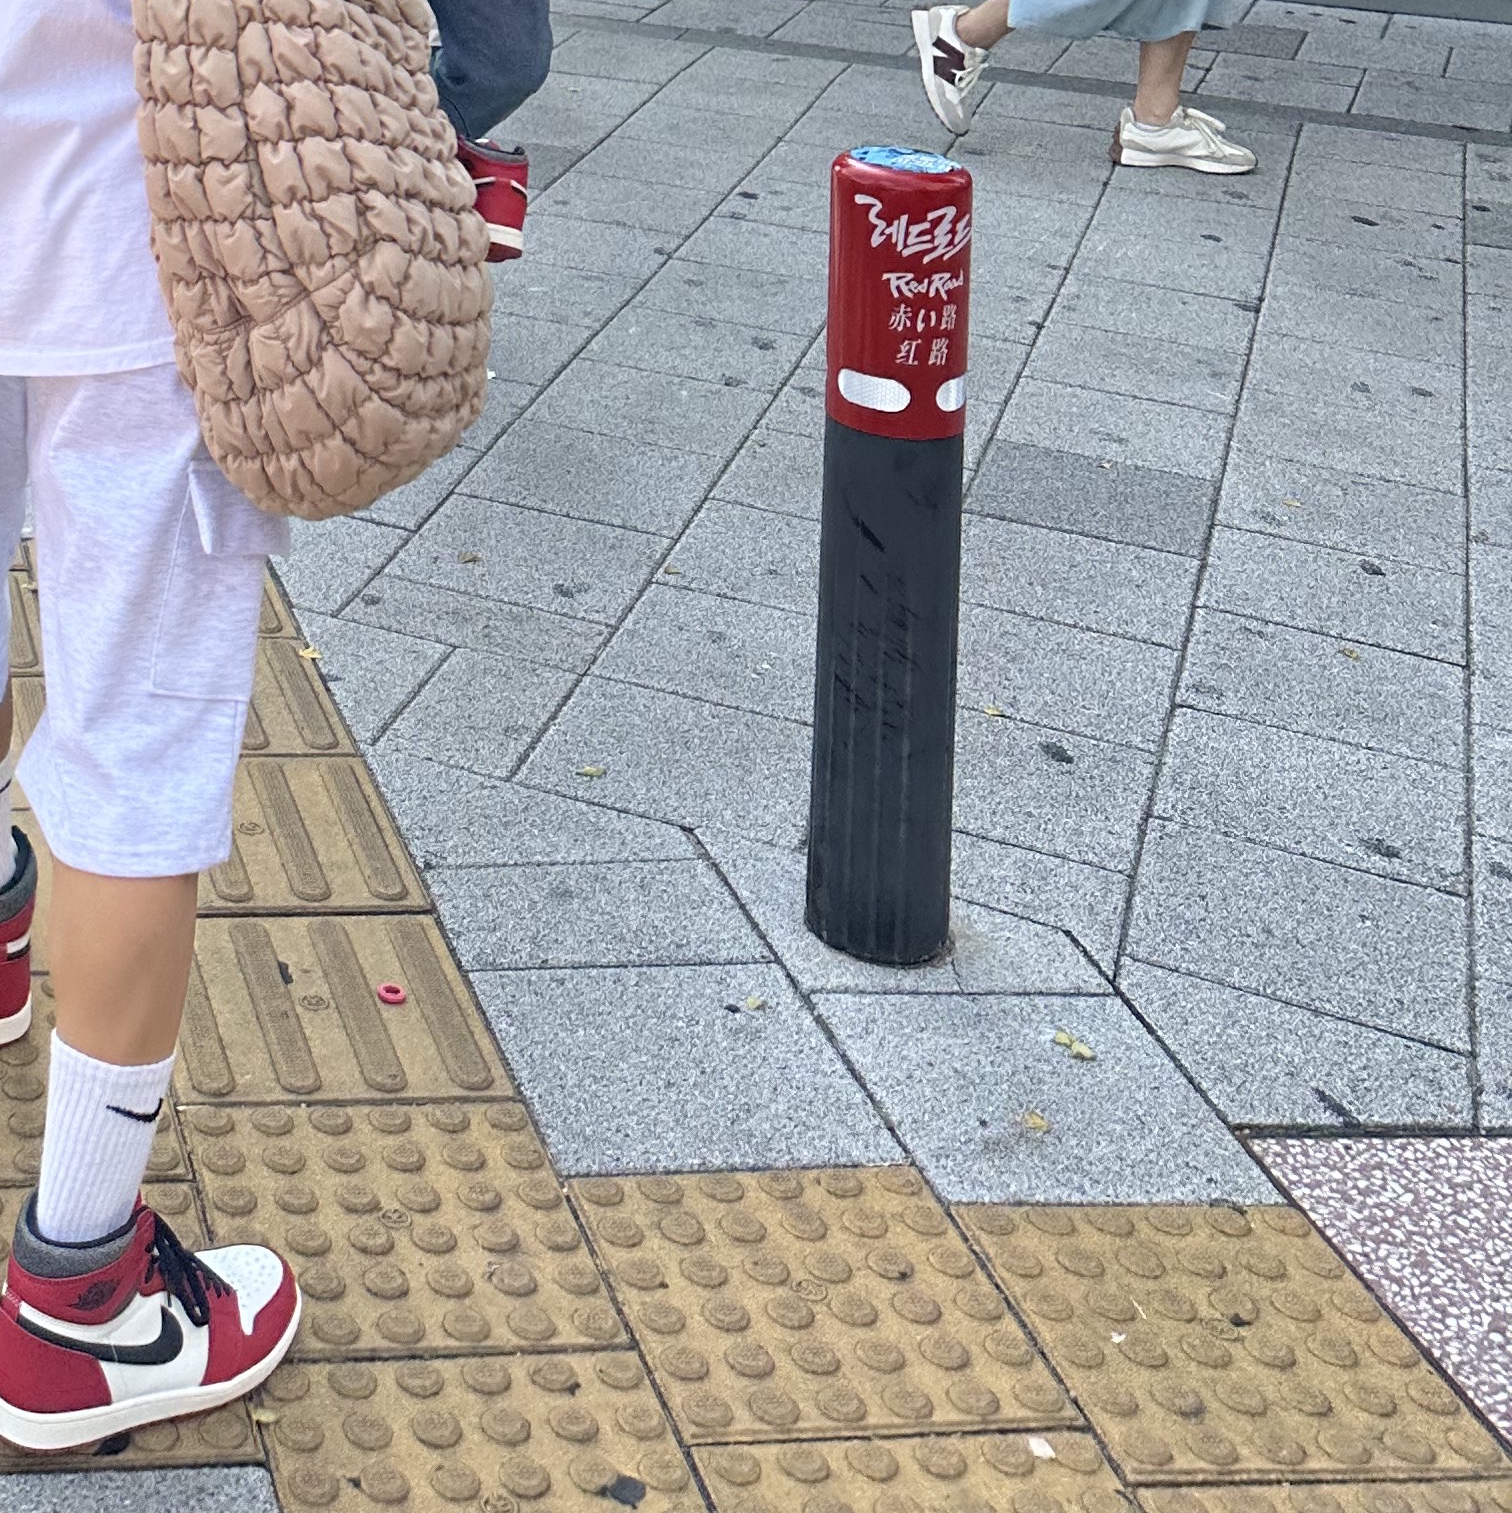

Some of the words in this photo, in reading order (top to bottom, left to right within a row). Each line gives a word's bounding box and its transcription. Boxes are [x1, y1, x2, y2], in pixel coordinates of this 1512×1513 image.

[854, 194, 973, 264] 레드로드
[888, 303, 957, 333] 赤い路
[895, 338, 949, 366] 红路
